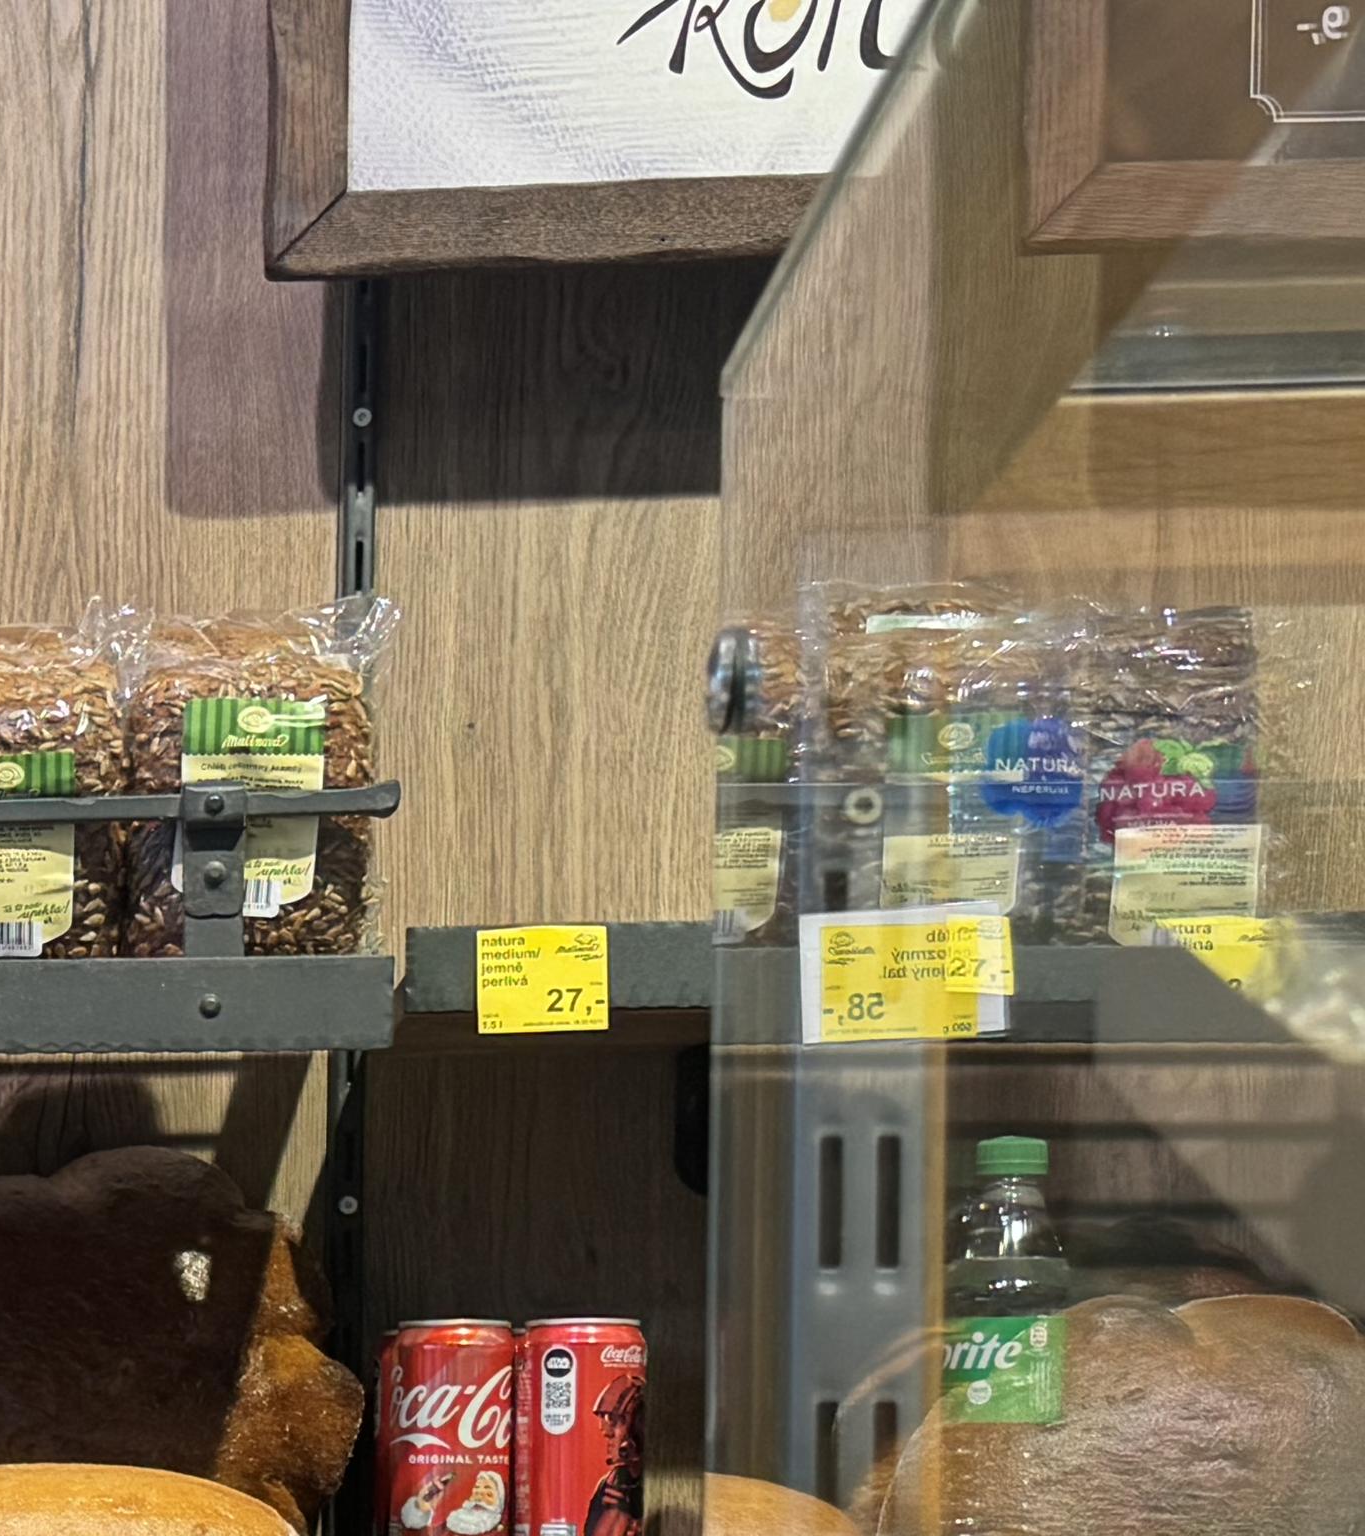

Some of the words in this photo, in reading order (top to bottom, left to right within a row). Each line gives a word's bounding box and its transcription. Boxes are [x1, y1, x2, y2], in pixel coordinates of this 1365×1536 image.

[1099, 781, 1206, 802] NATURA
[481, 935, 525, 947] natura
[481, 947, 541, 959] medium/
[481, 962, 523, 976] jemně
[482, 975, 528, 988] perlivá
[546, 987, 606, 1015] 27,-
[408, 1453, 473, 1466] ORIGINAL
